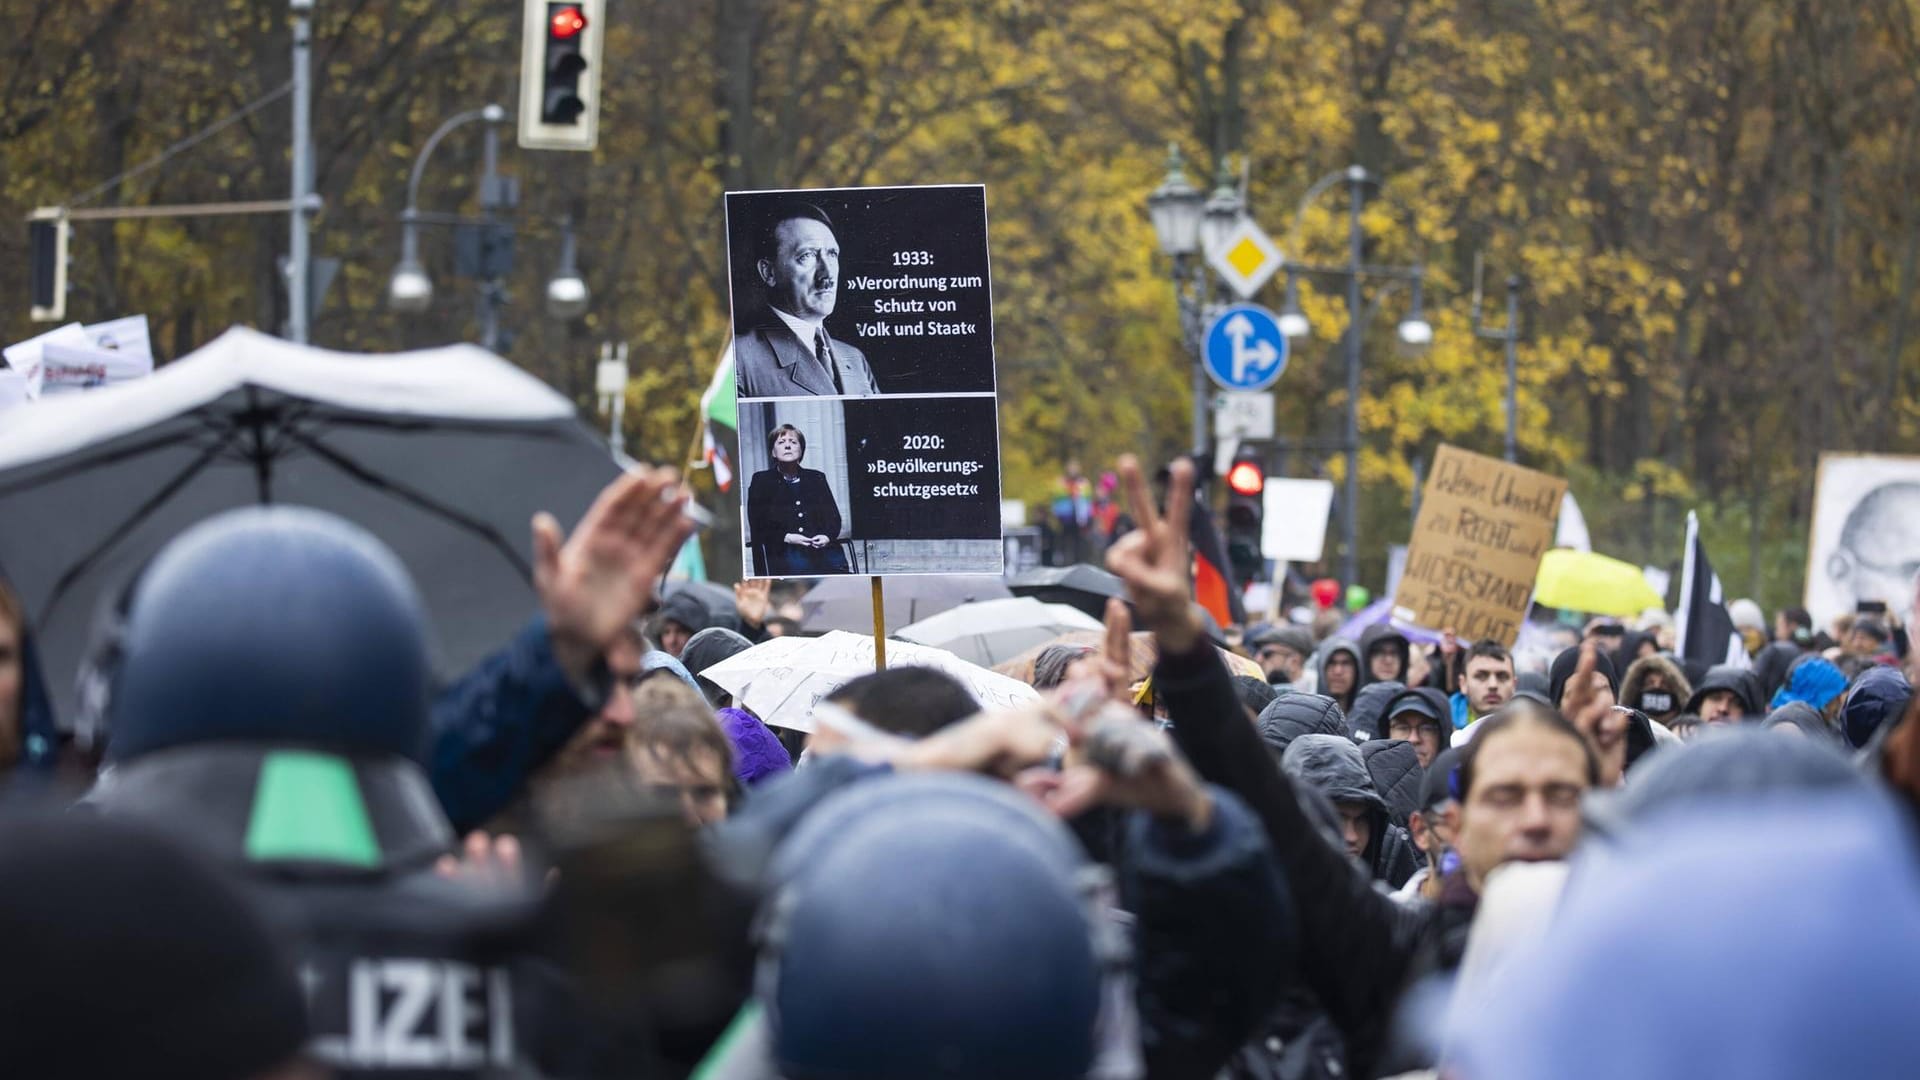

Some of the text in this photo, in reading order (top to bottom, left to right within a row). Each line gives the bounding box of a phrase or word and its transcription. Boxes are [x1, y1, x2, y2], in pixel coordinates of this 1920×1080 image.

[893, 251, 934, 266] 1933:
[847, 274, 982, 292] »Verordnung zum
[874, 298, 957, 313] Schutz von
[856, 321, 976, 337] Volk und Staat«
[903, 435, 945, 450] 2020:
[867, 458, 984, 476] »Bevölkerungs-
[873, 482, 979, 500] schutzgesetz«
[1455, 506, 1518, 550] RECHT
